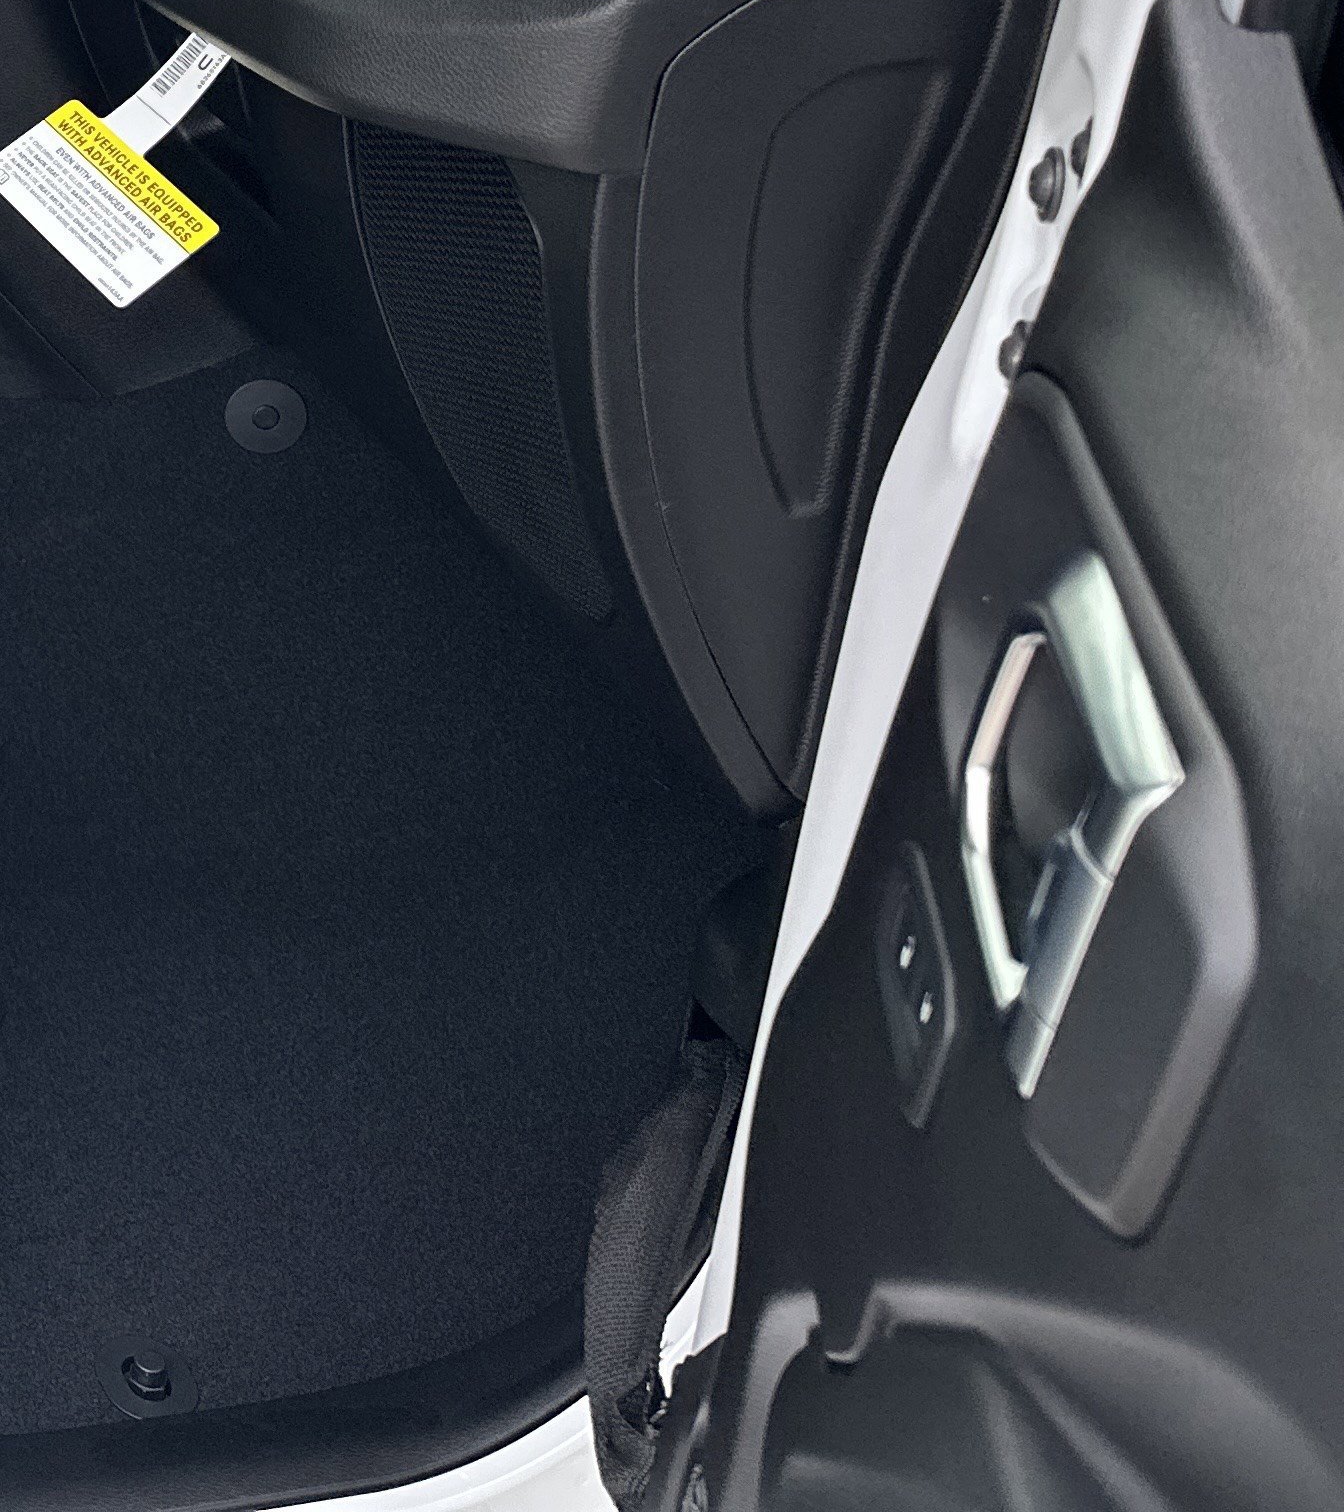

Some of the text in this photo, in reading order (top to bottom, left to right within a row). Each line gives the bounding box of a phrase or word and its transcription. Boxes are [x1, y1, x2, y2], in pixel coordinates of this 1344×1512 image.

[54, 146, 156, 240] EVEN WITH ADVANCED AIR BAGS
[55, 118, 193, 244] WITH ADVANCED AIR BAGS
[66, 109, 206, 234] THIS VEHICLE IS EQUIPPED
